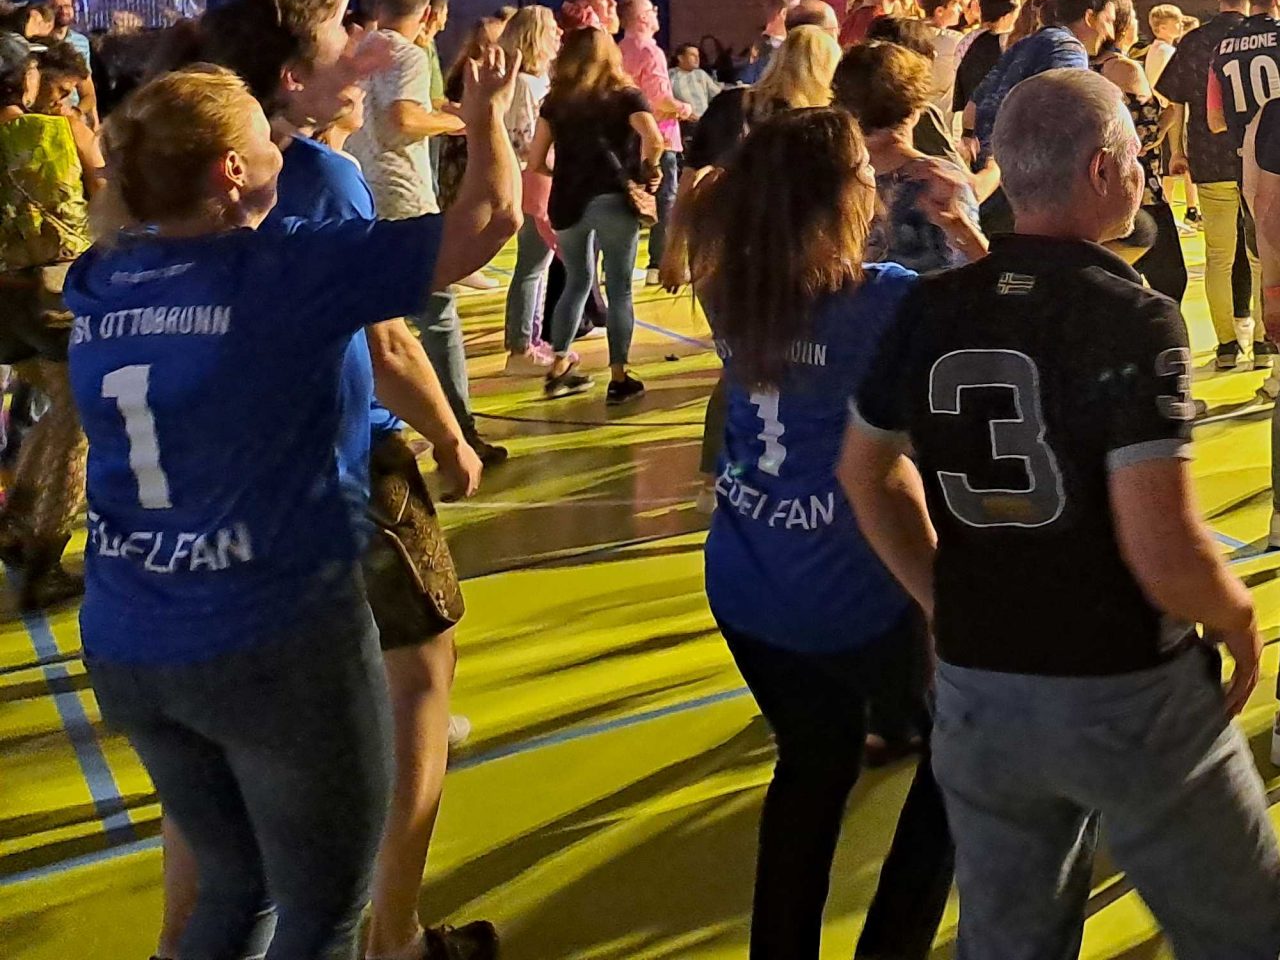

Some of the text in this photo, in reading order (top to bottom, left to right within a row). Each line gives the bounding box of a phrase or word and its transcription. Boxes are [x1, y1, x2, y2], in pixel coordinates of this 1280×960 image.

[100, 305, 231, 339] OTTOBRUNN
[102, 363, 172, 509] 1
[750, 390, 786, 477] 1
[929, 349, 1066, 527] 3
